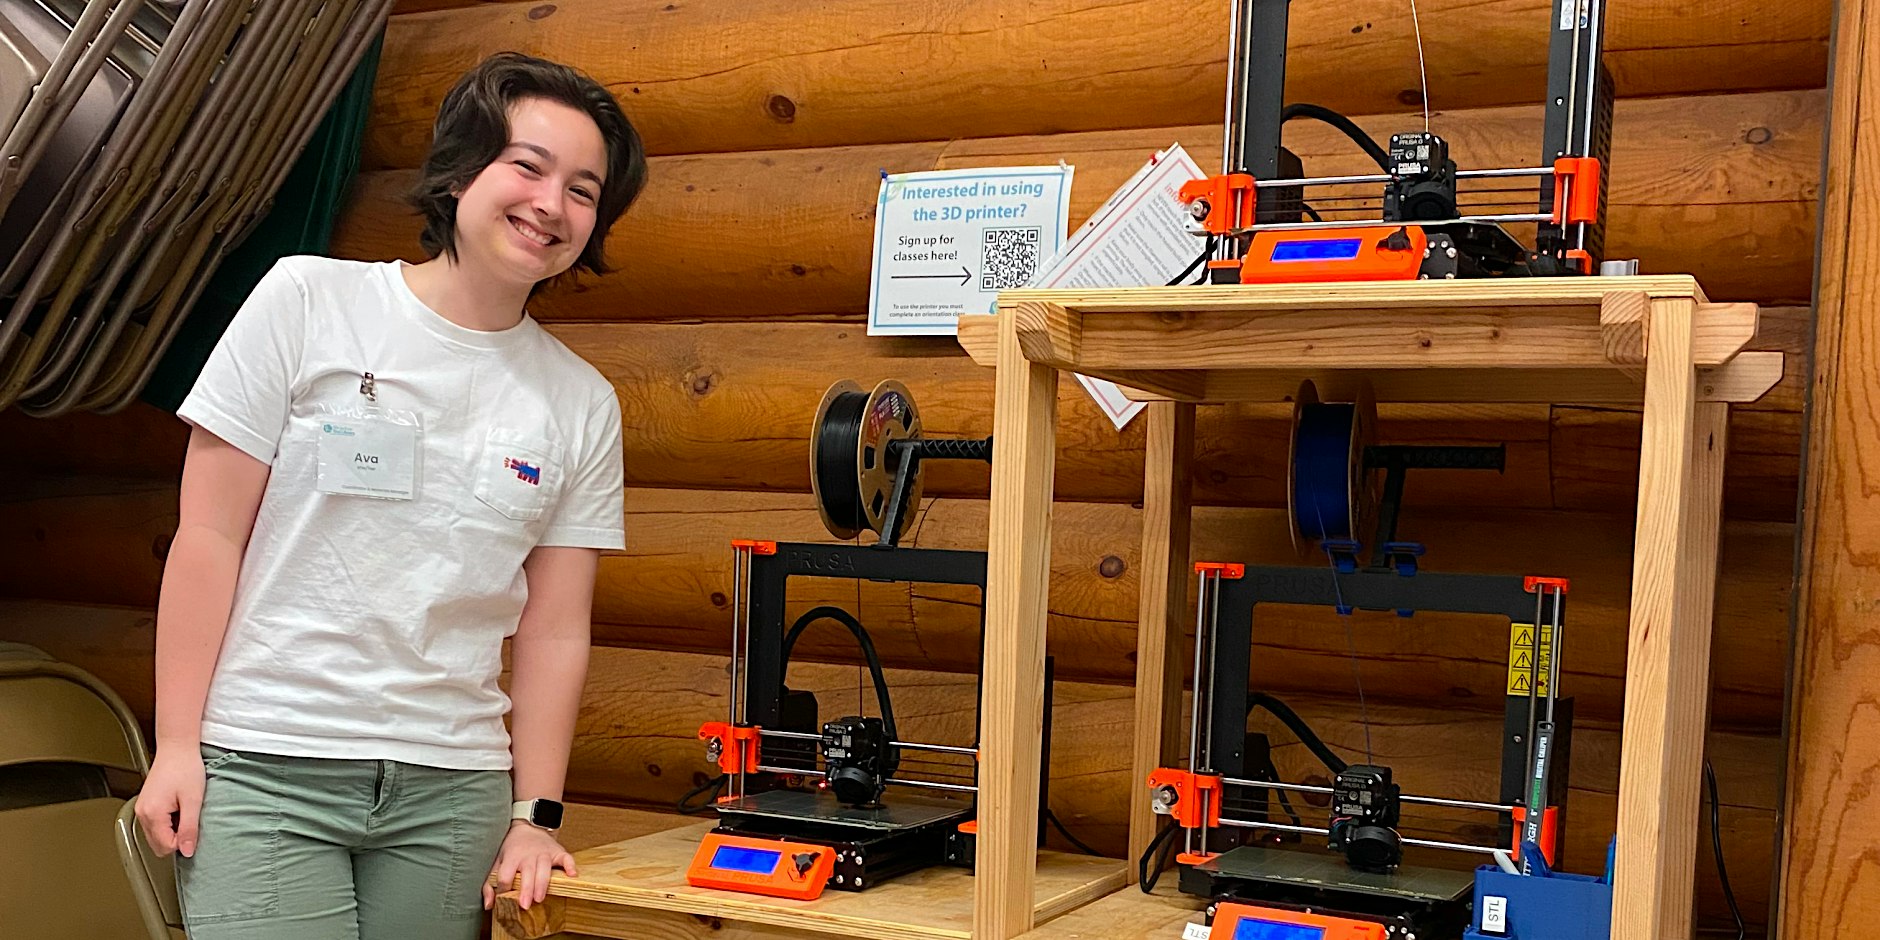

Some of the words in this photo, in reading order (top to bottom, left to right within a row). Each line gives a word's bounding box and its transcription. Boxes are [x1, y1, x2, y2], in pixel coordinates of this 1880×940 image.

[902, 182, 978, 200] Interested
[982, 182, 996, 196] in
[1001, 181, 1044, 198] using
[913, 208, 937, 222] the
[942, 206, 962, 220] 3D
[966, 204, 1027, 222] printer?
[899, 236, 921, 247] Sign
[924, 237, 936, 247] up
[939, 234, 954, 244] for
[893, 252, 928, 261] classes
[931, 250, 958, 260] here!
[354, 453, 379, 464] Ava
[786, 550, 855, 572] PRUSA
[1488, 900, 1499, 922] STL
[1188, 928, 1209, 940] STL
